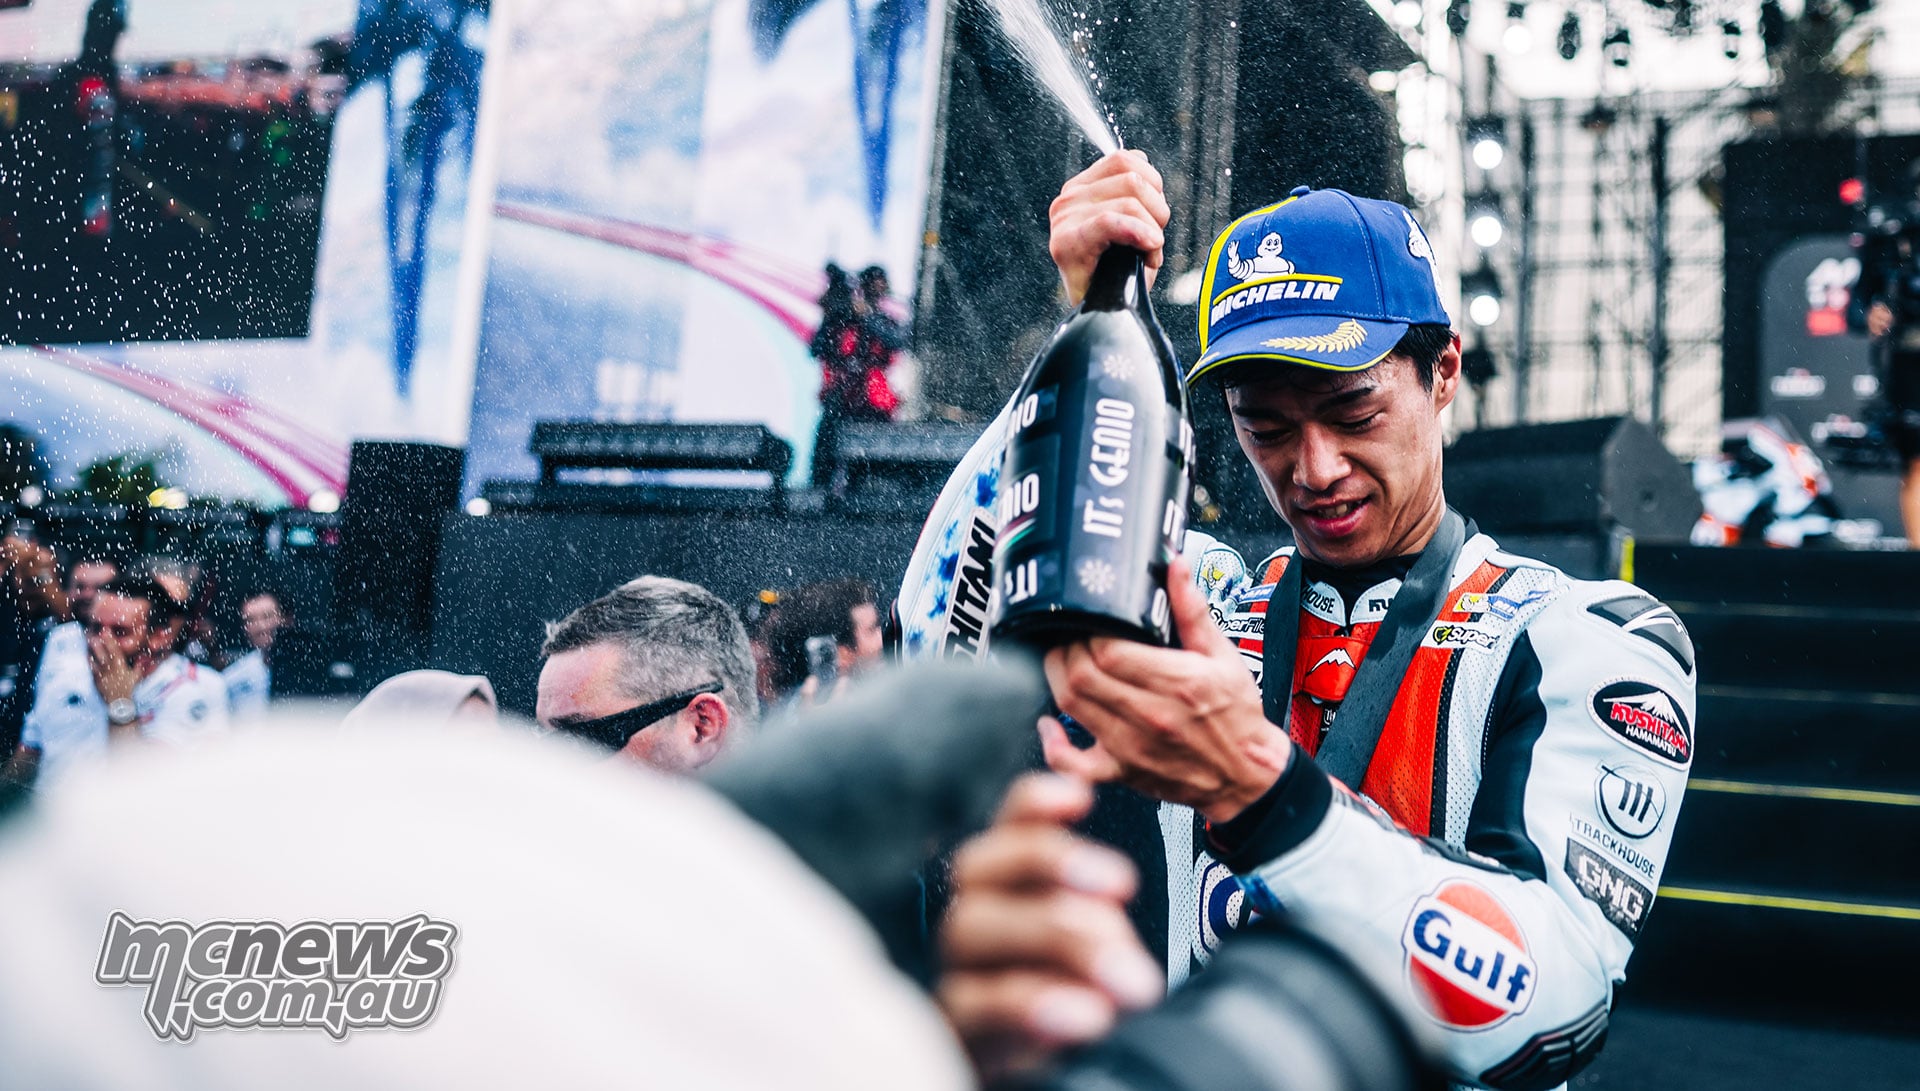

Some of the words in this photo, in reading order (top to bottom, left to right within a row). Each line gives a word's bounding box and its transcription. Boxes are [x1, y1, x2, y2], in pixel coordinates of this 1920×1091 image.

[1211, 281, 1340, 327] MICHELIN
[1089, 398, 1135, 487] GENIO
[944, 516, 996, 656] HITANI
[1301, 584, 1335, 614] HOUSE
[1447, 625, 1500, 650] Super
[1610, 702, 1689, 759] KUSHITANI
[1626, 724, 1676, 757] HAMAMATSU
[1574, 818, 1656, 880] TRACKHOUSE
[1579, 853, 1645, 922] GMG
[1413, 909, 1531, 1003] Gulf
